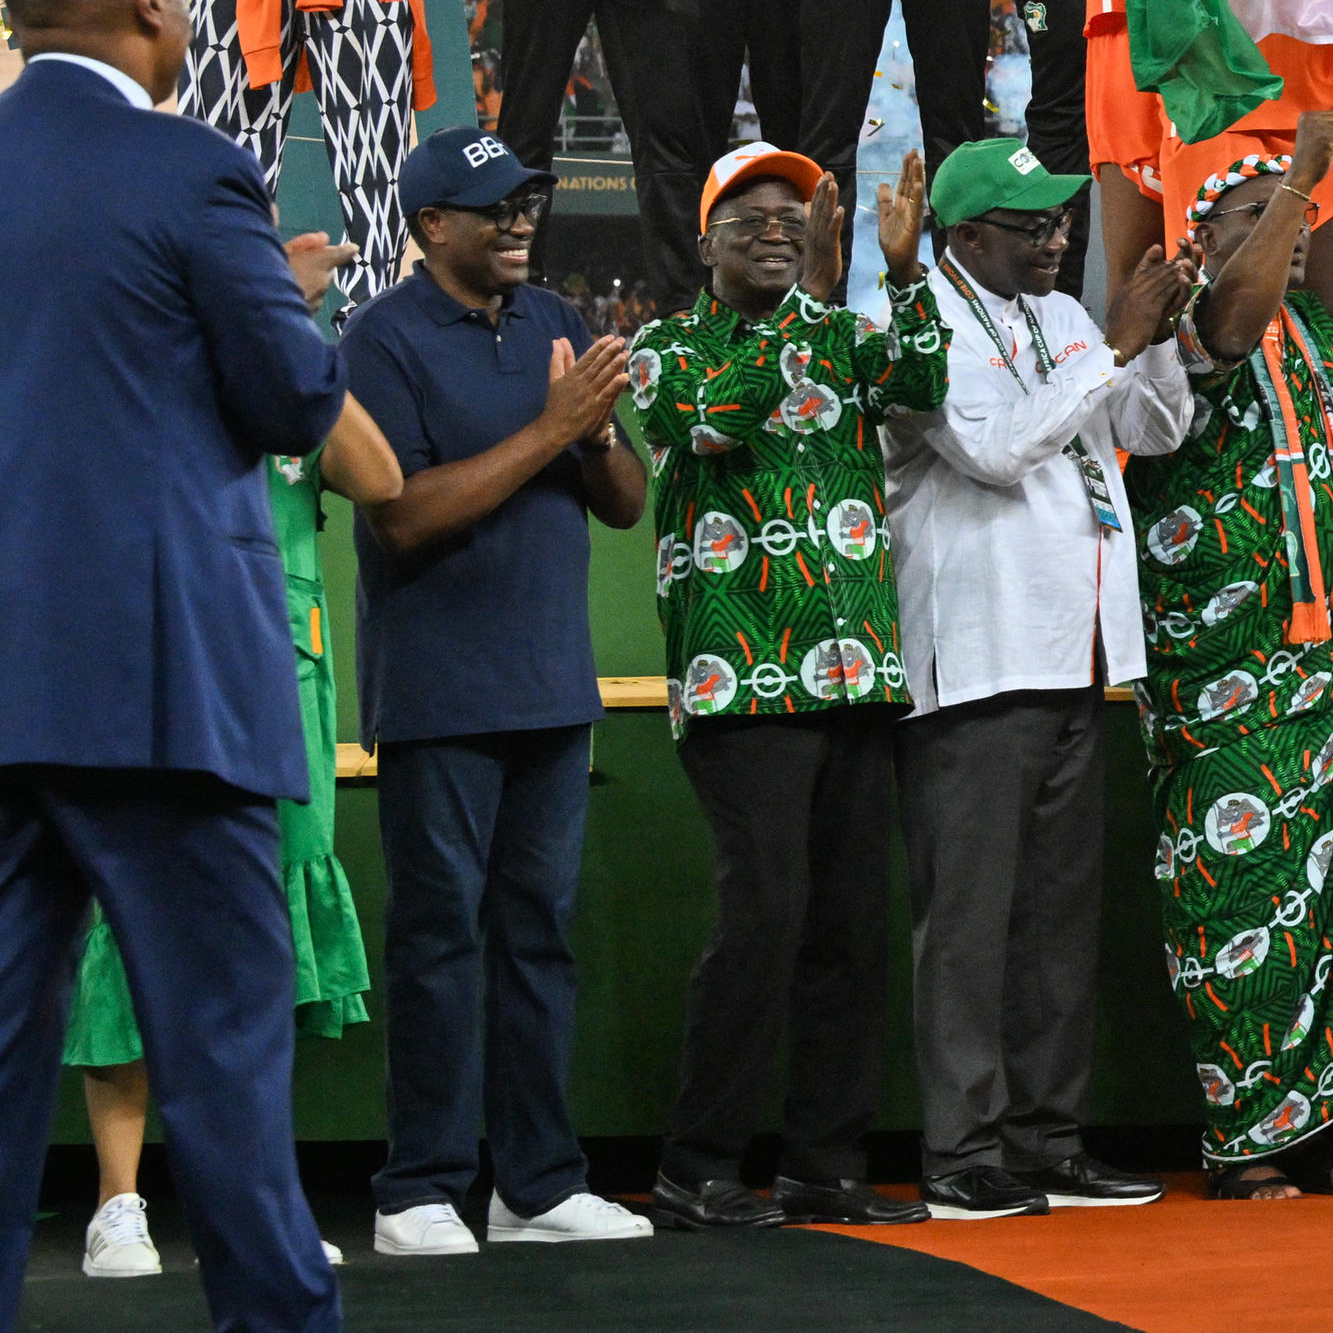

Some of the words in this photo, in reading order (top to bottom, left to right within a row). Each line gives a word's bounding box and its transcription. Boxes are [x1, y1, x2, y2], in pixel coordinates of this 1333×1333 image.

[556, 176, 628, 190] NATIONS
[970, 297, 993, 329] NATIONS
[988, 326, 998, 338] OF
[1033, 333, 1044, 348] CUP
